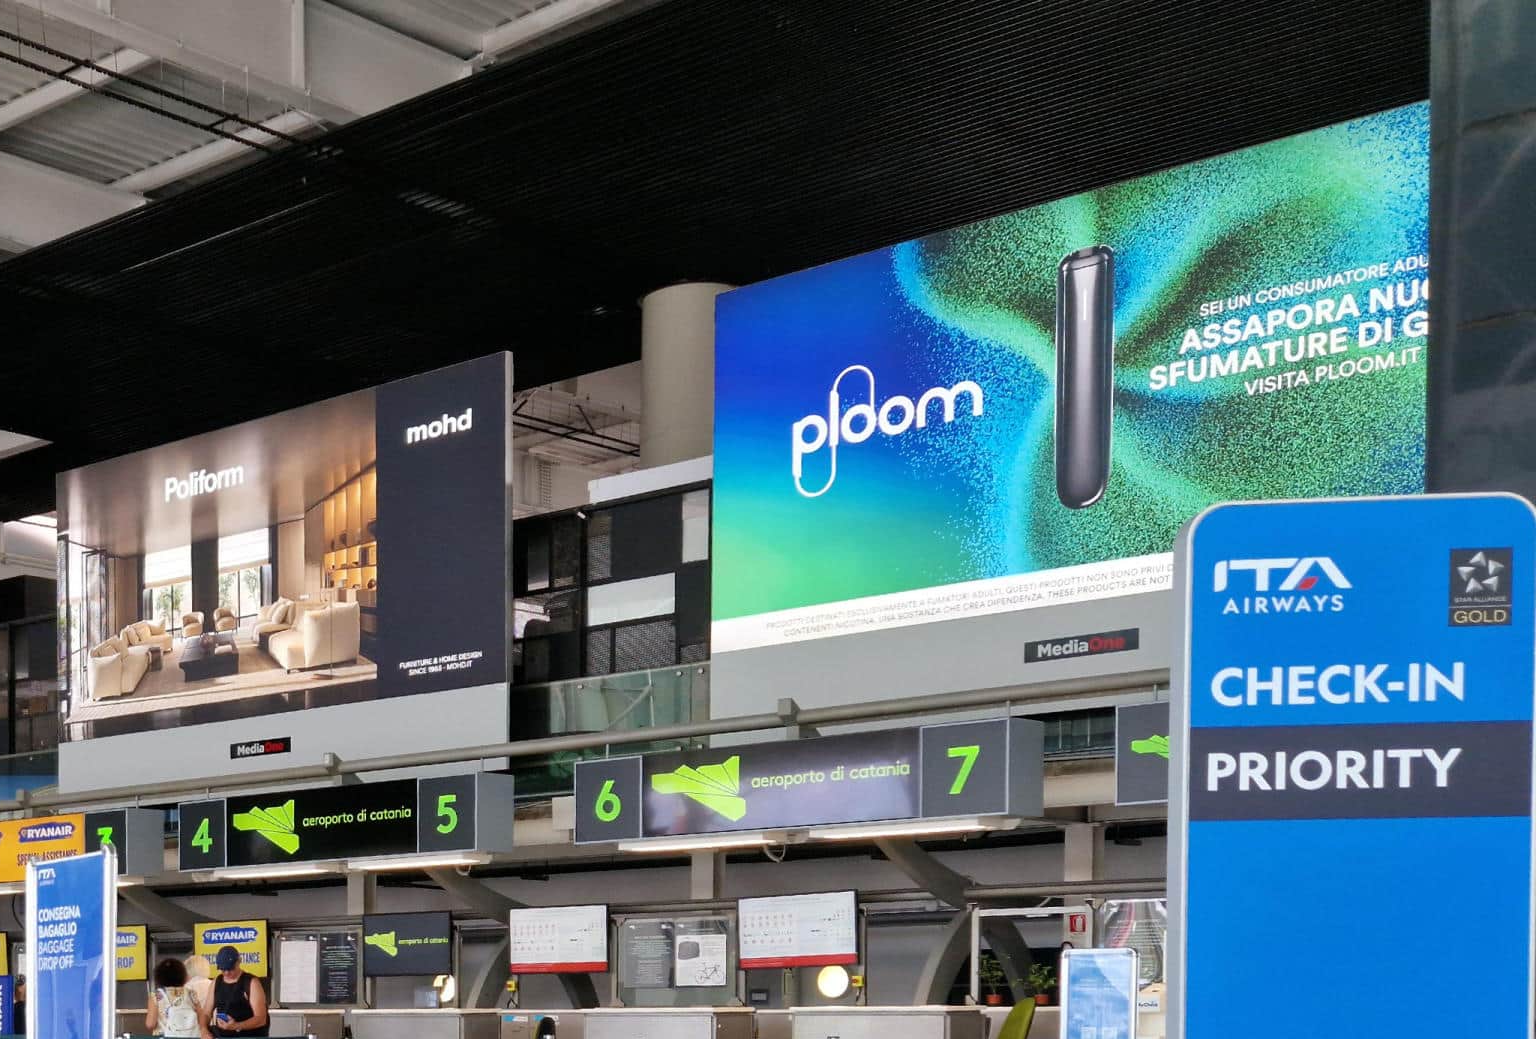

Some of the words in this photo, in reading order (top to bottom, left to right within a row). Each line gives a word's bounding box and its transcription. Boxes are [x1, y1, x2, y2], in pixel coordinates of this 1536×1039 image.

[1199, 302, 1225, 317] SEI
[1229, 294, 1252, 311] UN
[1255, 262, 1389, 305] CONSUMATORE
[1179, 293, 1360, 354] ASSAPORA
[1149, 326, 1348, 391] SFUMATURE
[1358, 316, 1393, 348] DI
[1244, 370, 1310, 396] VISITA
[1315, 346, 1422, 383] PLOOM.IT
[407, 407, 472, 444] mohd
[792, 364, 984, 498] ploom
[165, 465, 244, 502] Poliform
[1087, 571, 1108, 583] NON
[1110, 567, 1136, 580] SONO
[1140, 563, 1165, 576] PRIVI
[1214, 556, 1353, 592] ITA
[963, 600, 985, 611] CREA
[1048, 587, 1075, 599] THESE
[1077, 580, 1127, 597] PRODUCTS
[1129, 576, 1147, 587] ARE
[1149, 574, 1170, 585] NOT
[1222, 595, 1345, 615] AIRWAYS
[1454, 609, 1506, 624] GOLD
[1037, 635, 1126, 659] MediaOne
[399, 657, 432, 670] FURNITURE
[439, 654, 458, 664] HOME
[458, 650, 483, 661] DESIGN
[408, 666, 427, 677] SINCE
[1211, 661, 1465, 708] CHECK-IN
[237, 741, 284, 757] MediaOne
[1207, 747, 1463, 791] PRIORITY
[595, 780, 622, 822] 6
[751, 769, 825, 791] aeroporto
[830, 766, 845, 781] di
[849, 760, 910, 780] catania
[947, 745, 980, 795] 7
[27, 825, 73, 839] RYANAIR
[191, 818, 213, 853] 4
[302, 811, 354, 829] aeroporto
[356, 808, 367, 822] di
[369, 805, 412, 821] catania
[437, 794, 458, 834] 5
[38, 905, 81, 922] CONSEGNA
[38, 921, 77, 938] BAGAGLIO
[116, 935, 136, 945] NAIR
[211, 930, 256, 941] RYANAIR
[38, 939, 74, 955] BAGGAGE
[38, 956, 58, 972] DROP
[58, 955, 75, 969] OFF
[117, 957, 135, 968] ROP
